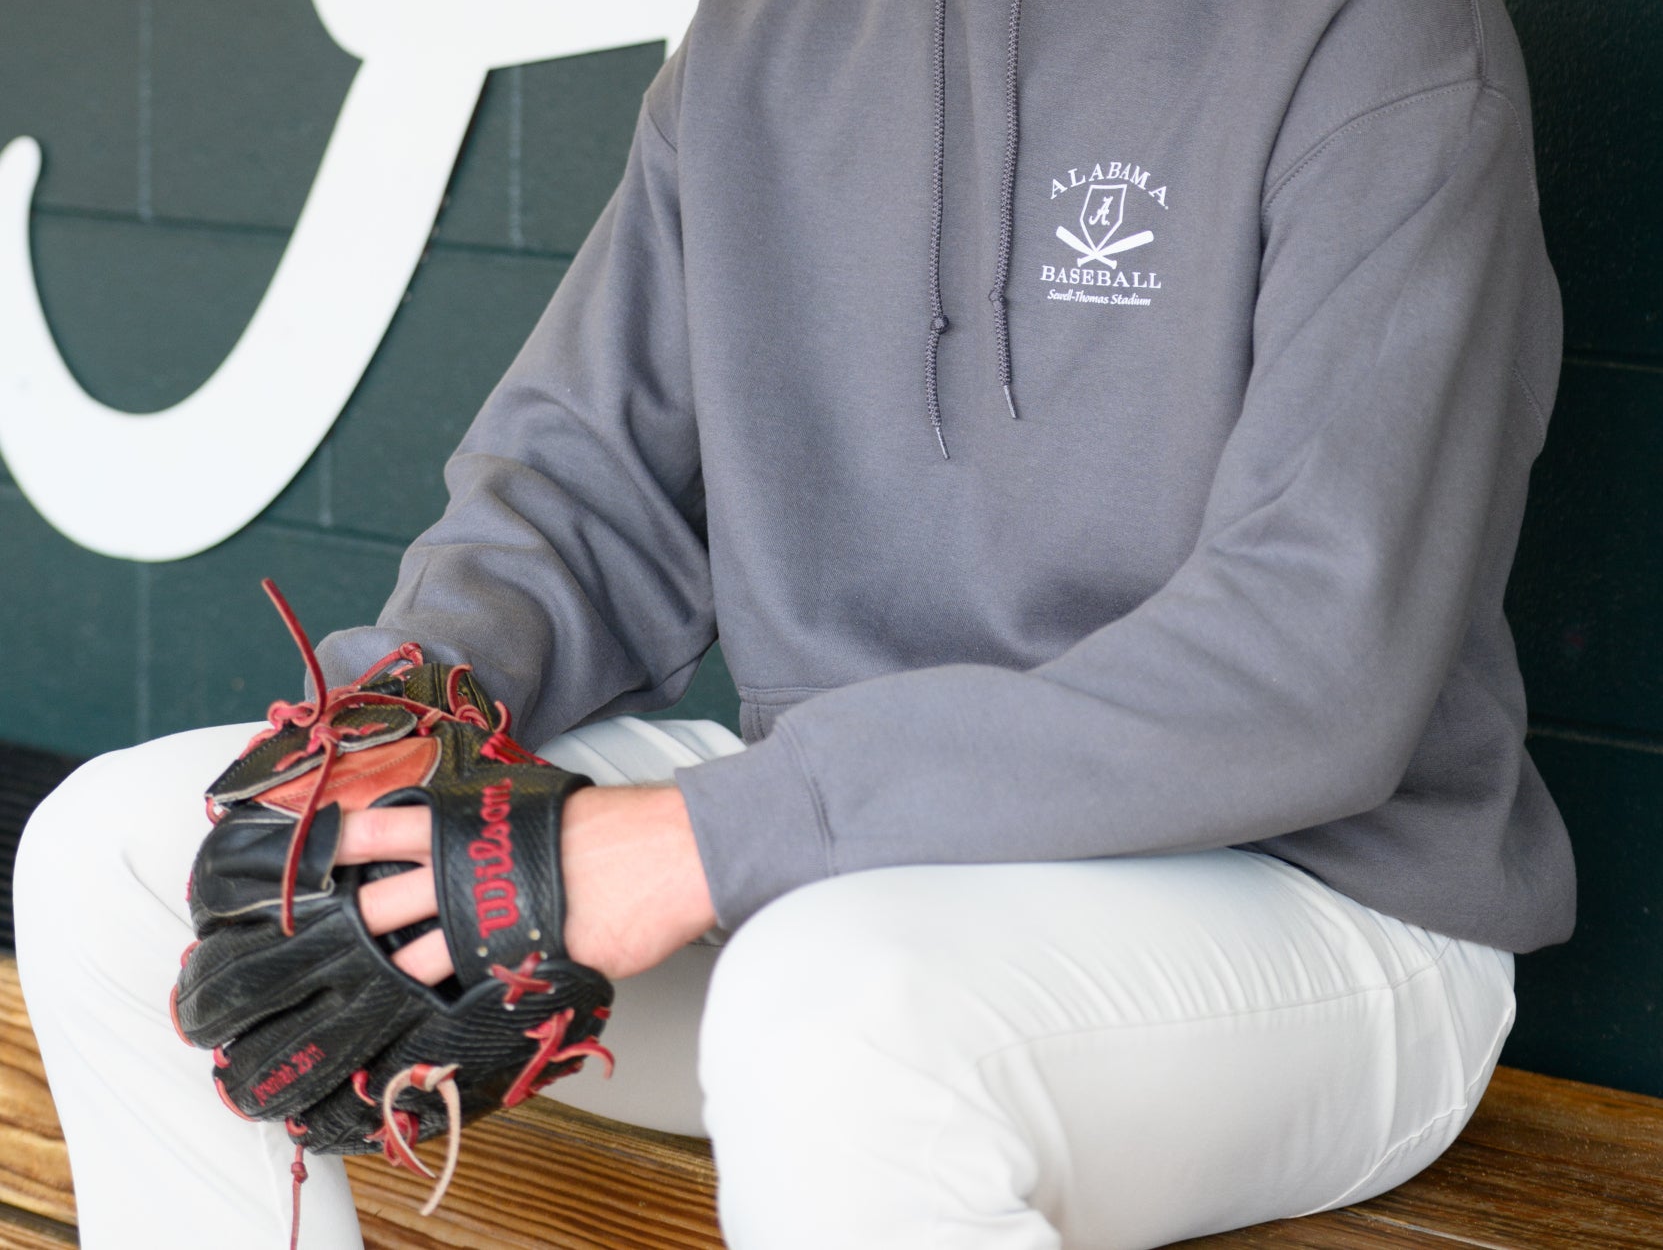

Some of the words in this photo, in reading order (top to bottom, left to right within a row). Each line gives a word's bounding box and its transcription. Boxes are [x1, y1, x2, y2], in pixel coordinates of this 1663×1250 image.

[1050, 161, 1167, 207] ALABAMA
[1040, 265, 1161, 288] BASEBALL
[1047, 289, 1109, 304] Sewell-Thomas
[1110, 293, 1151, 306] Stadium
[468, 777, 520, 939] Wilson
